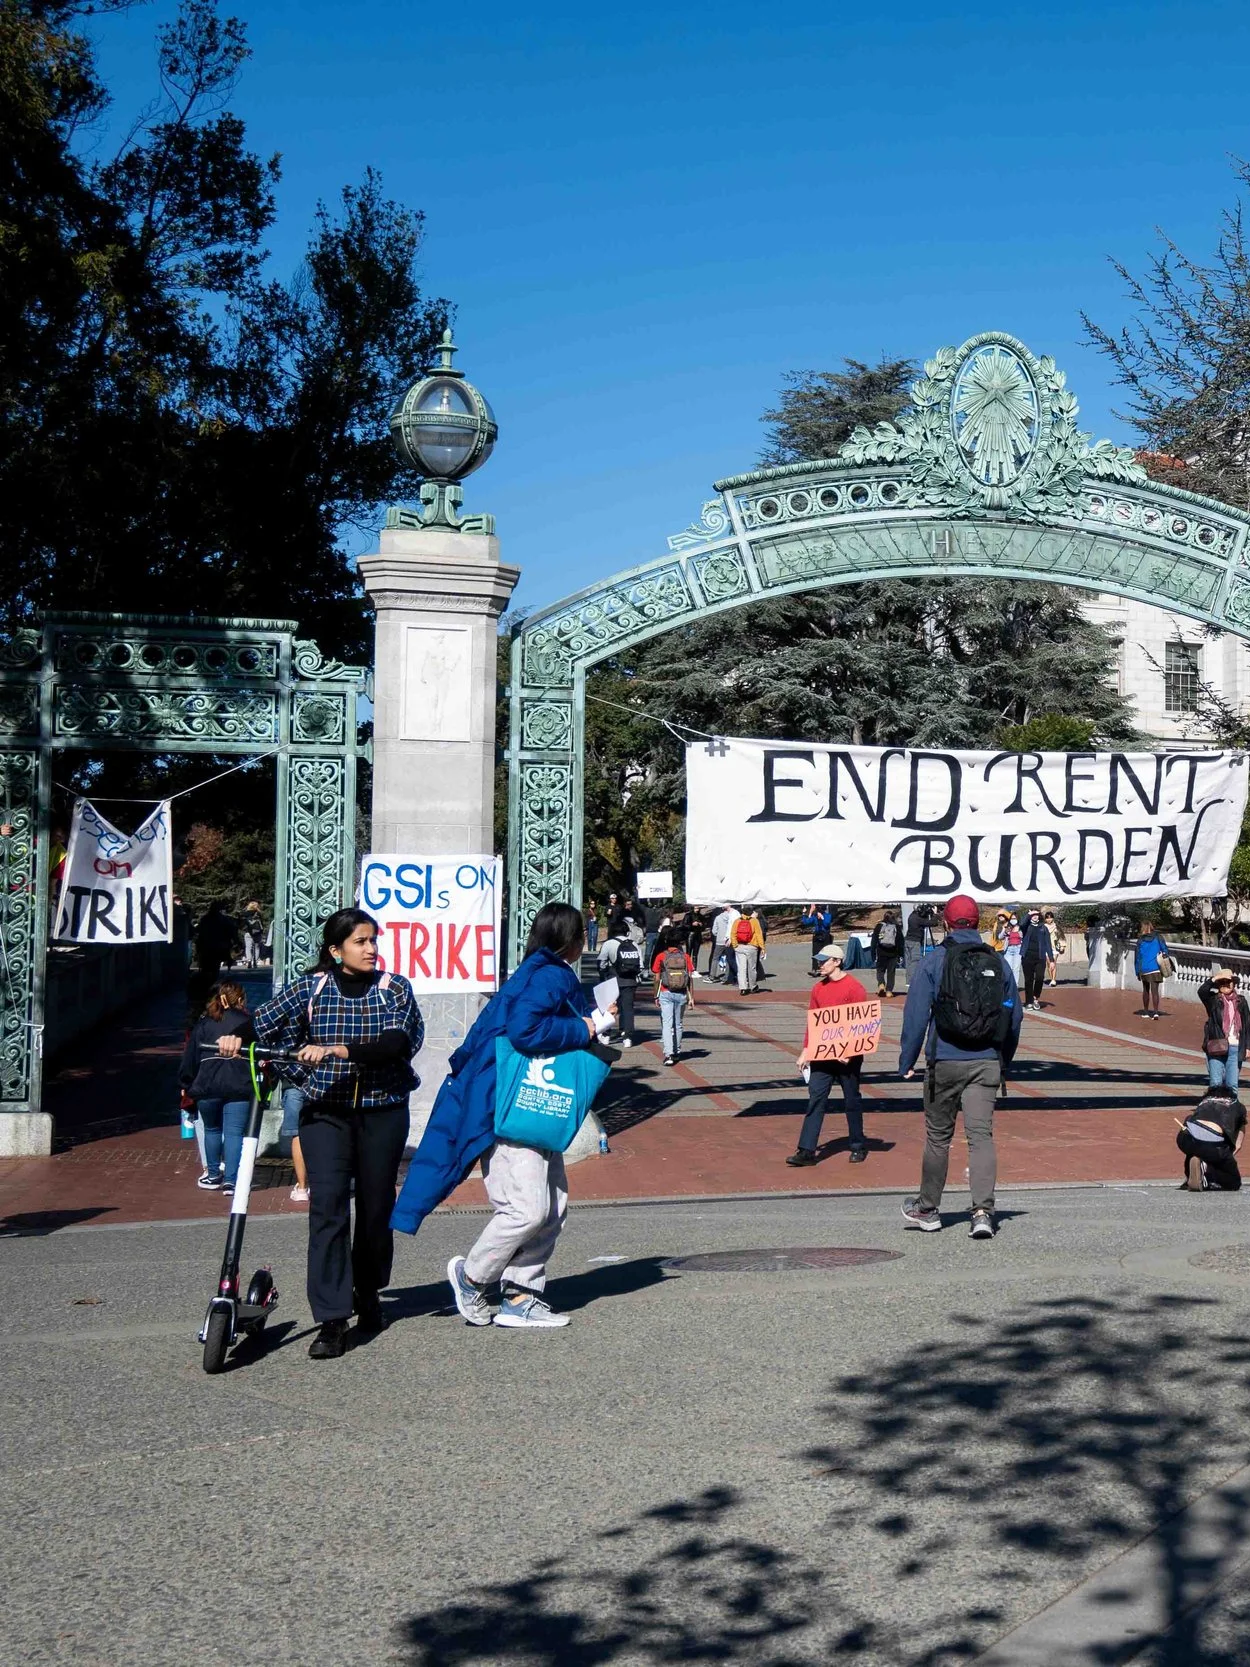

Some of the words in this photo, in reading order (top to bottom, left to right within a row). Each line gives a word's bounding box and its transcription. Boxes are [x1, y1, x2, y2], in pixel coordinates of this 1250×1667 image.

[1037, 531, 1138, 578] GATE
[747, 748, 962, 832] END
[984, 751, 1223, 819] RENT
[890, 799, 1225, 895] BURDEN
[455, 864, 497, 891] ON
[620, 951, 639, 959] VANS
[813, 1008, 841, 1027] YOU
[846, 1003, 878, 1021] HAVE
[821, 1026, 845, 1041] OUR
[847, 1018, 882, 1038] MONEY
[814, 1041, 849, 1060] PAY
[854, 1035, 875, 1053] US
[543, 1104, 570, 1114] LIBRARY
